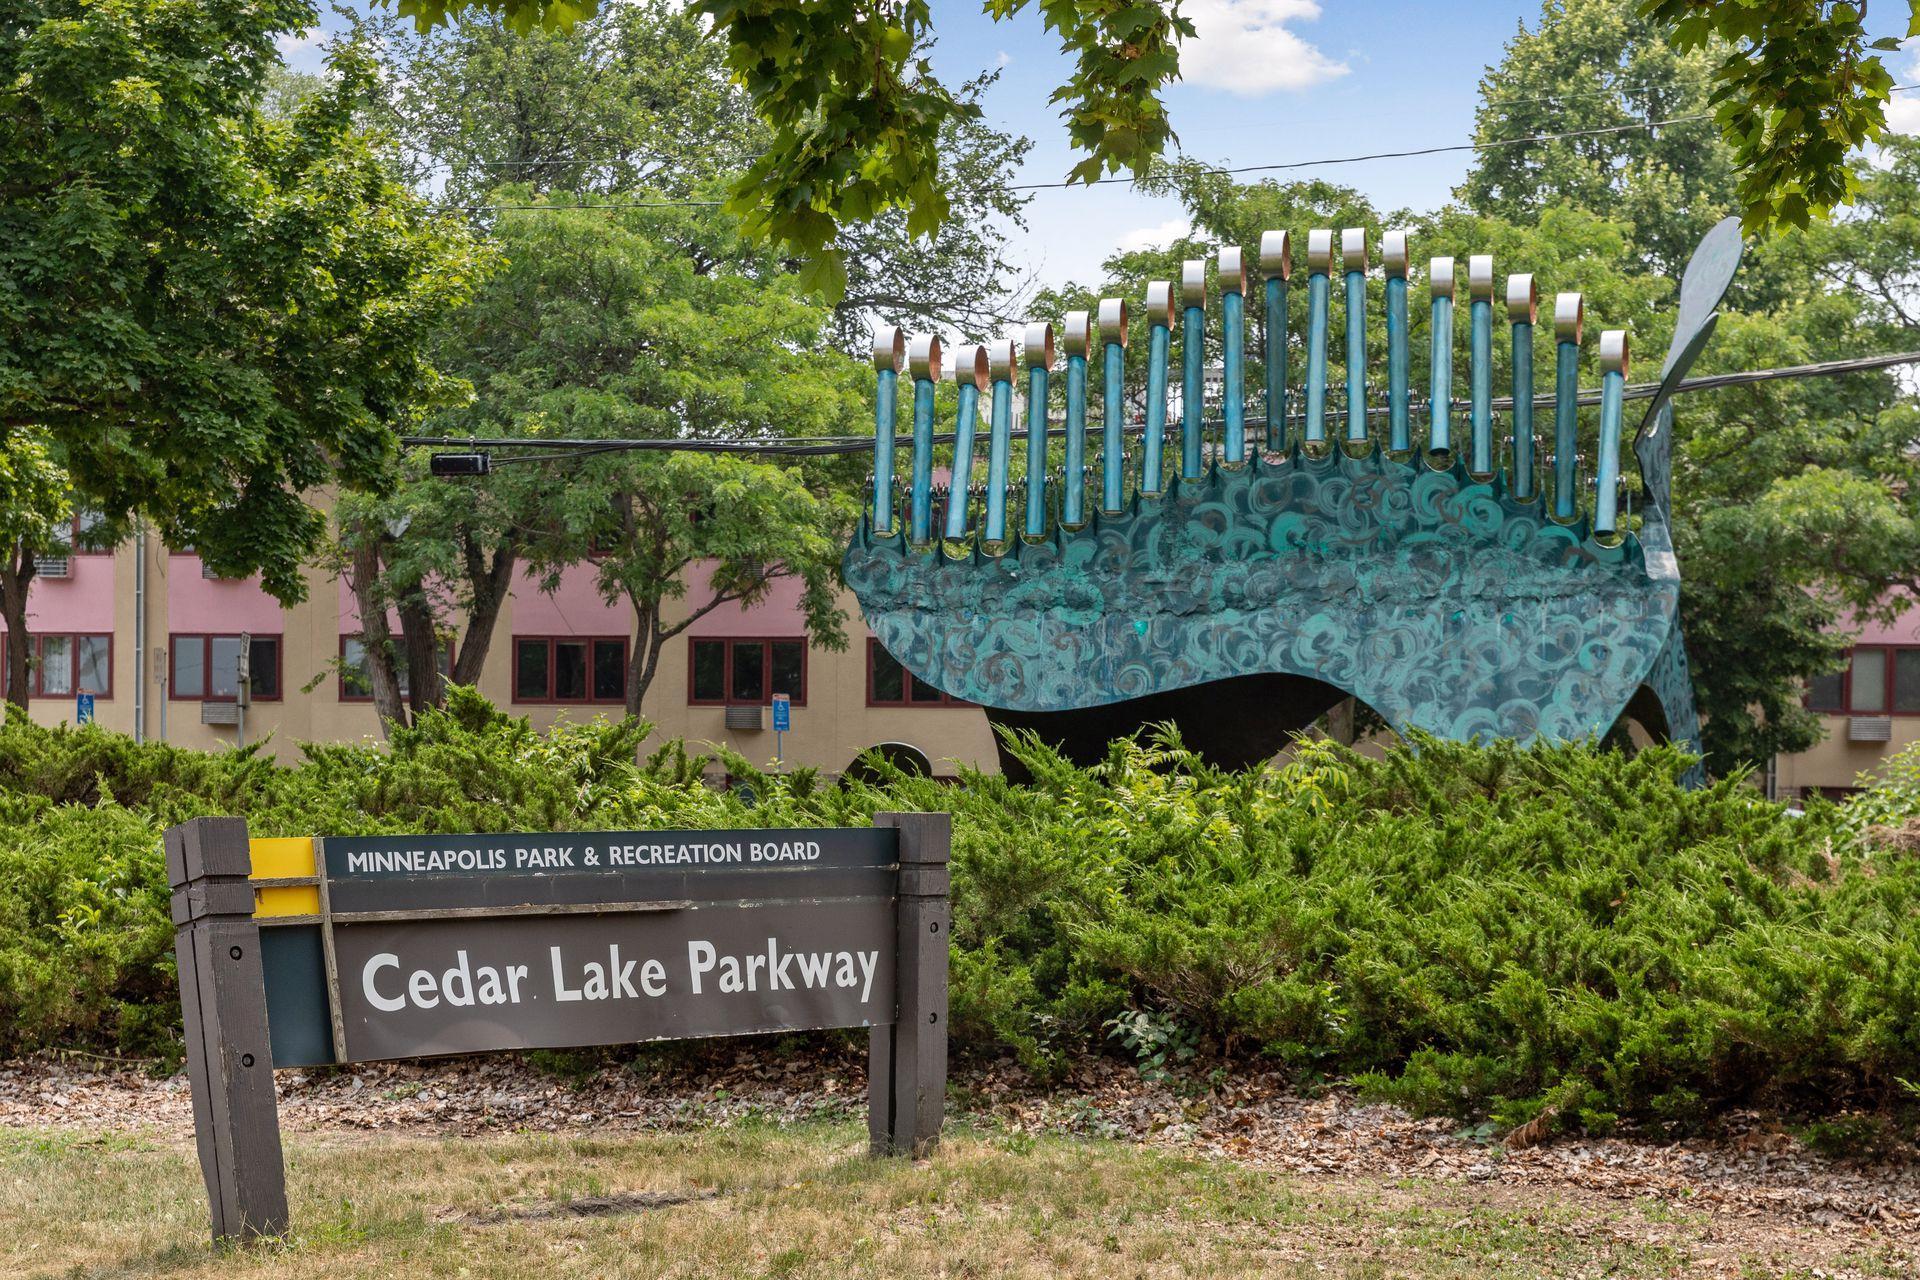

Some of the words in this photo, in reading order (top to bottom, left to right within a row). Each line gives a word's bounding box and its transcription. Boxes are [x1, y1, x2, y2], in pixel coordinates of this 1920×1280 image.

[347, 849, 507, 873] MINNEAPOLIS
[515, 847, 575, 868] PARK
[583, 846, 601, 866] &
[609, 843, 742, 865] RECREATION
[750, 841, 820, 862] BOARD
[362, 949, 528, 1012] Cedar
[550, 943, 667, 1002] Lake
[687, 937, 879, 1003] Parkway
